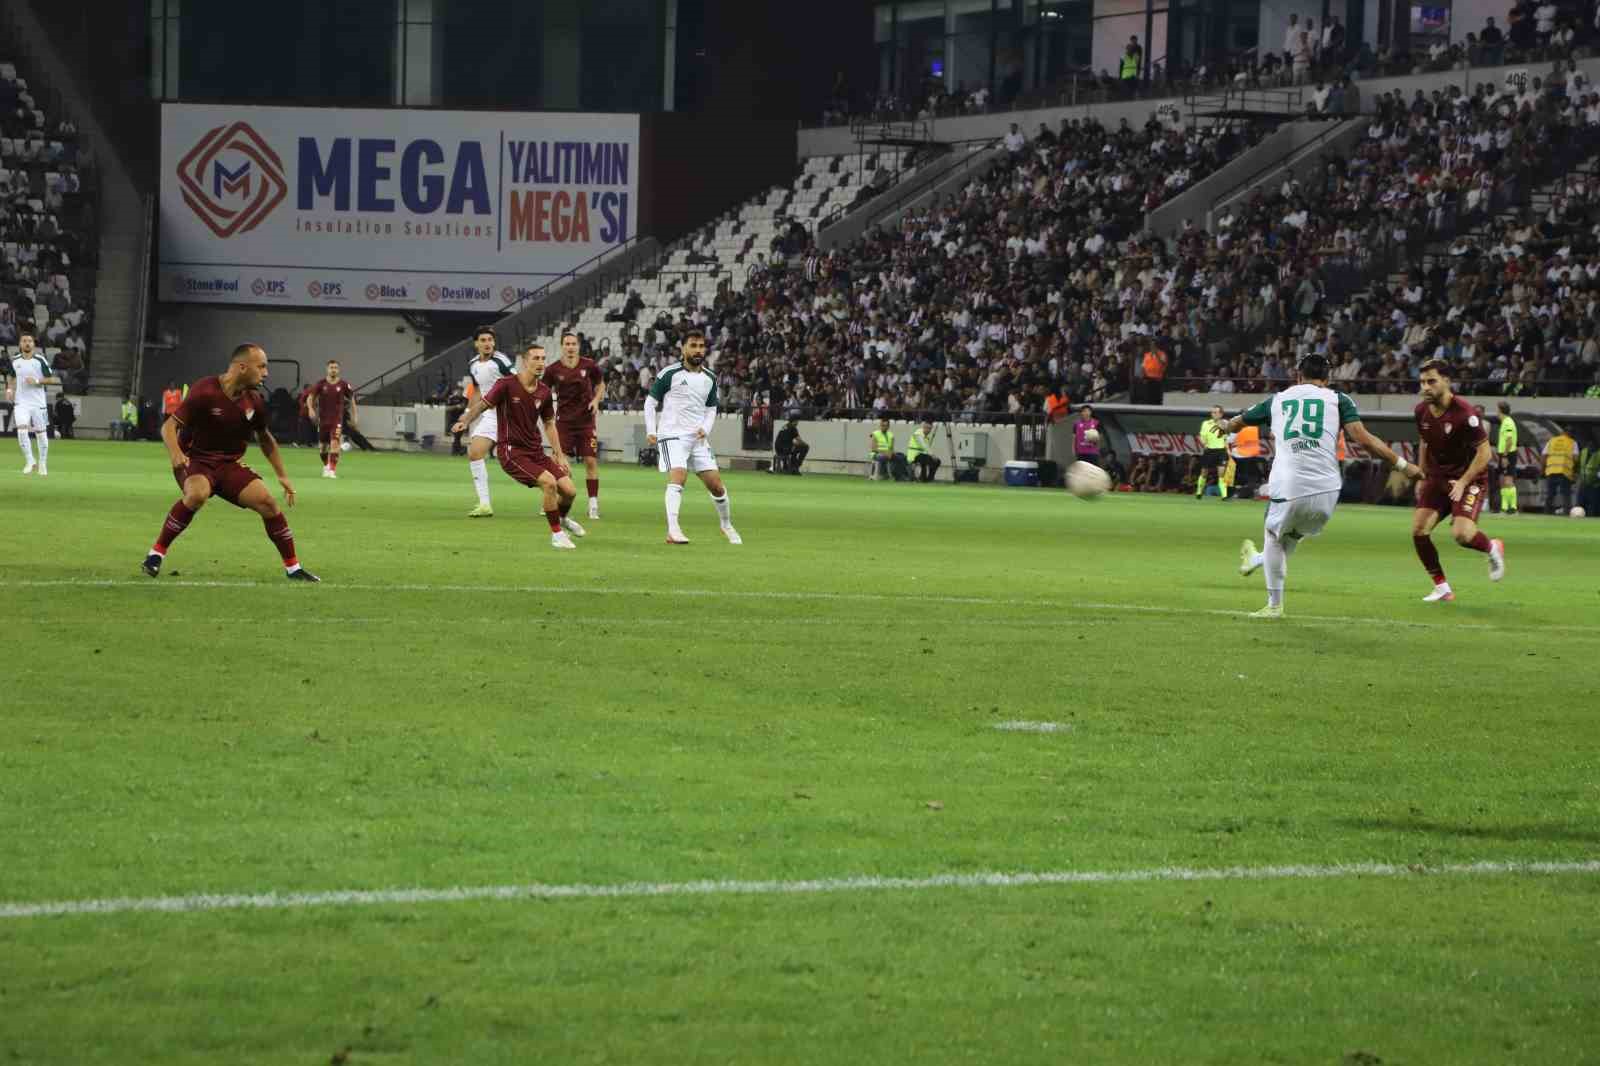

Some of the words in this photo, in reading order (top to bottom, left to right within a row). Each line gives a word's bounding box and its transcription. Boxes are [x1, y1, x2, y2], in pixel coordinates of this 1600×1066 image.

[508, 141, 628, 184] YALITIMIN
[297, 137, 491, 214] MEGA
[509, 190, 627, 243] MEGA'SI
[296, 219, 391, 234] Insulation
[404, 221, 493, 236] Solutions
[187, 278, 238, 291] StoneWool
[322, 283, 341, 295] EPS
[380, 285, 407, 297] Block
[442, 287, 490, 299] DesiWool
[1281, 398, 1324, 440] 29
